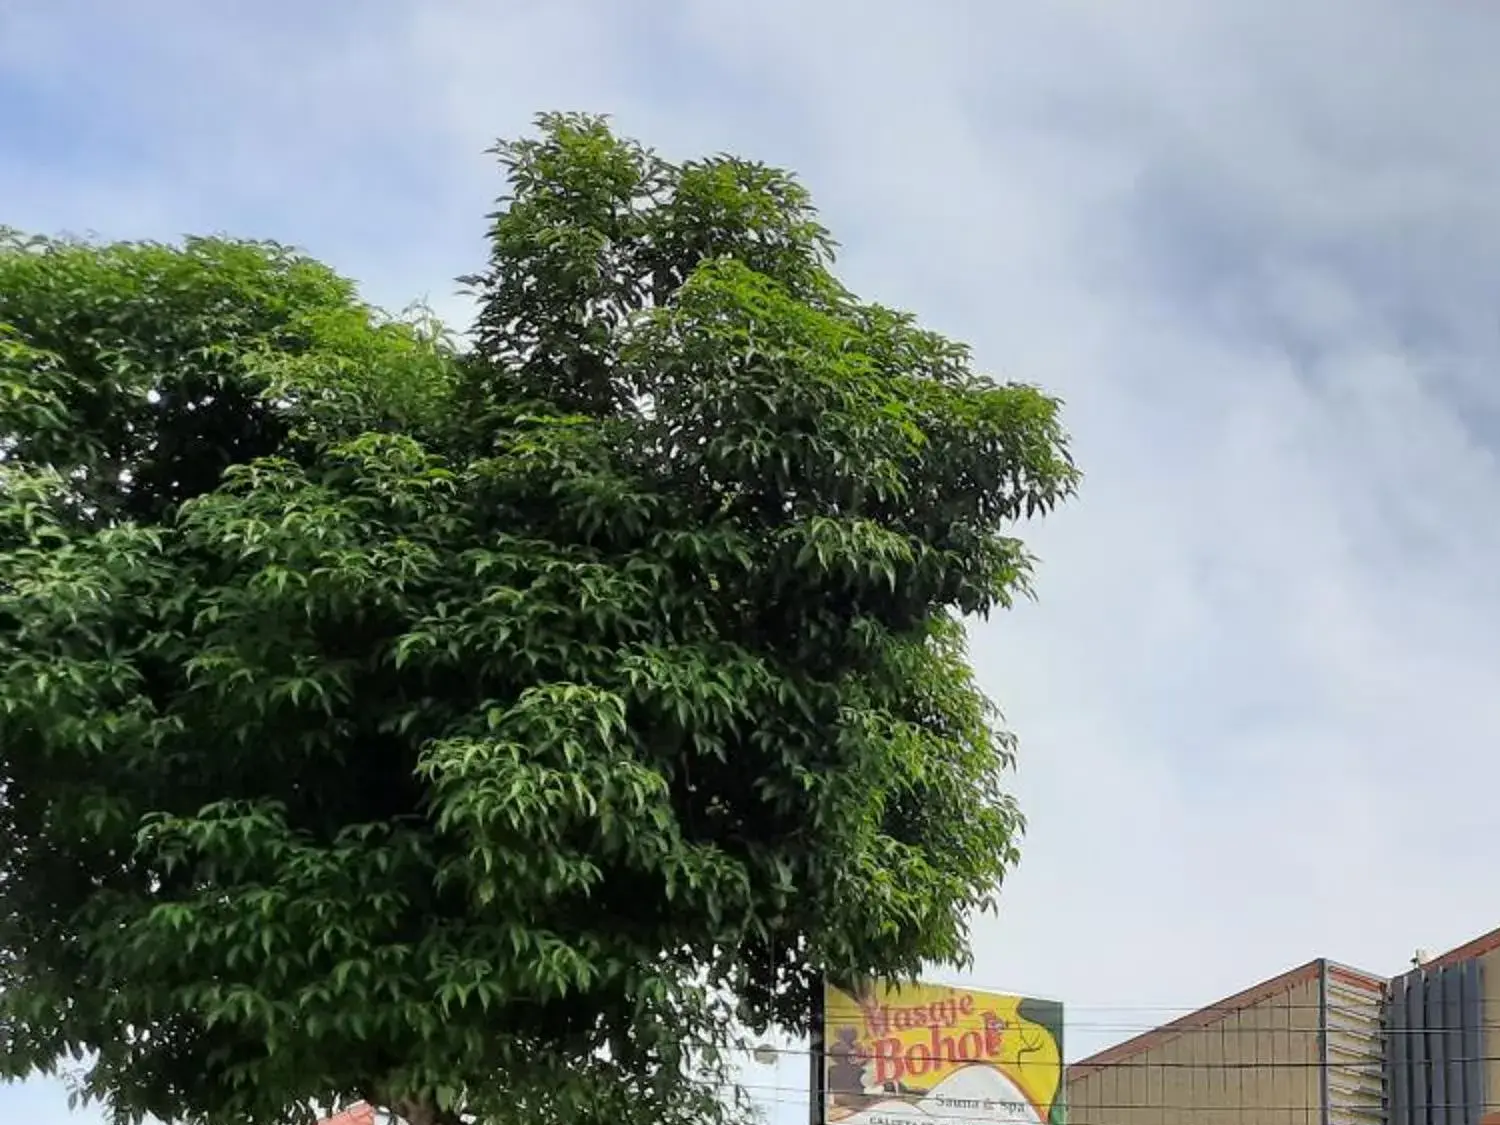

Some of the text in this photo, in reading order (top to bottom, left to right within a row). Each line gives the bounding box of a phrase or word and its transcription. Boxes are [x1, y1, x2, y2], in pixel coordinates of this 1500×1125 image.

[874, 1010, 1004, 1086] Bohol
[935, 1093, 979, 1109] Sauna
[999, 1099, 1025, 1114] Spa
